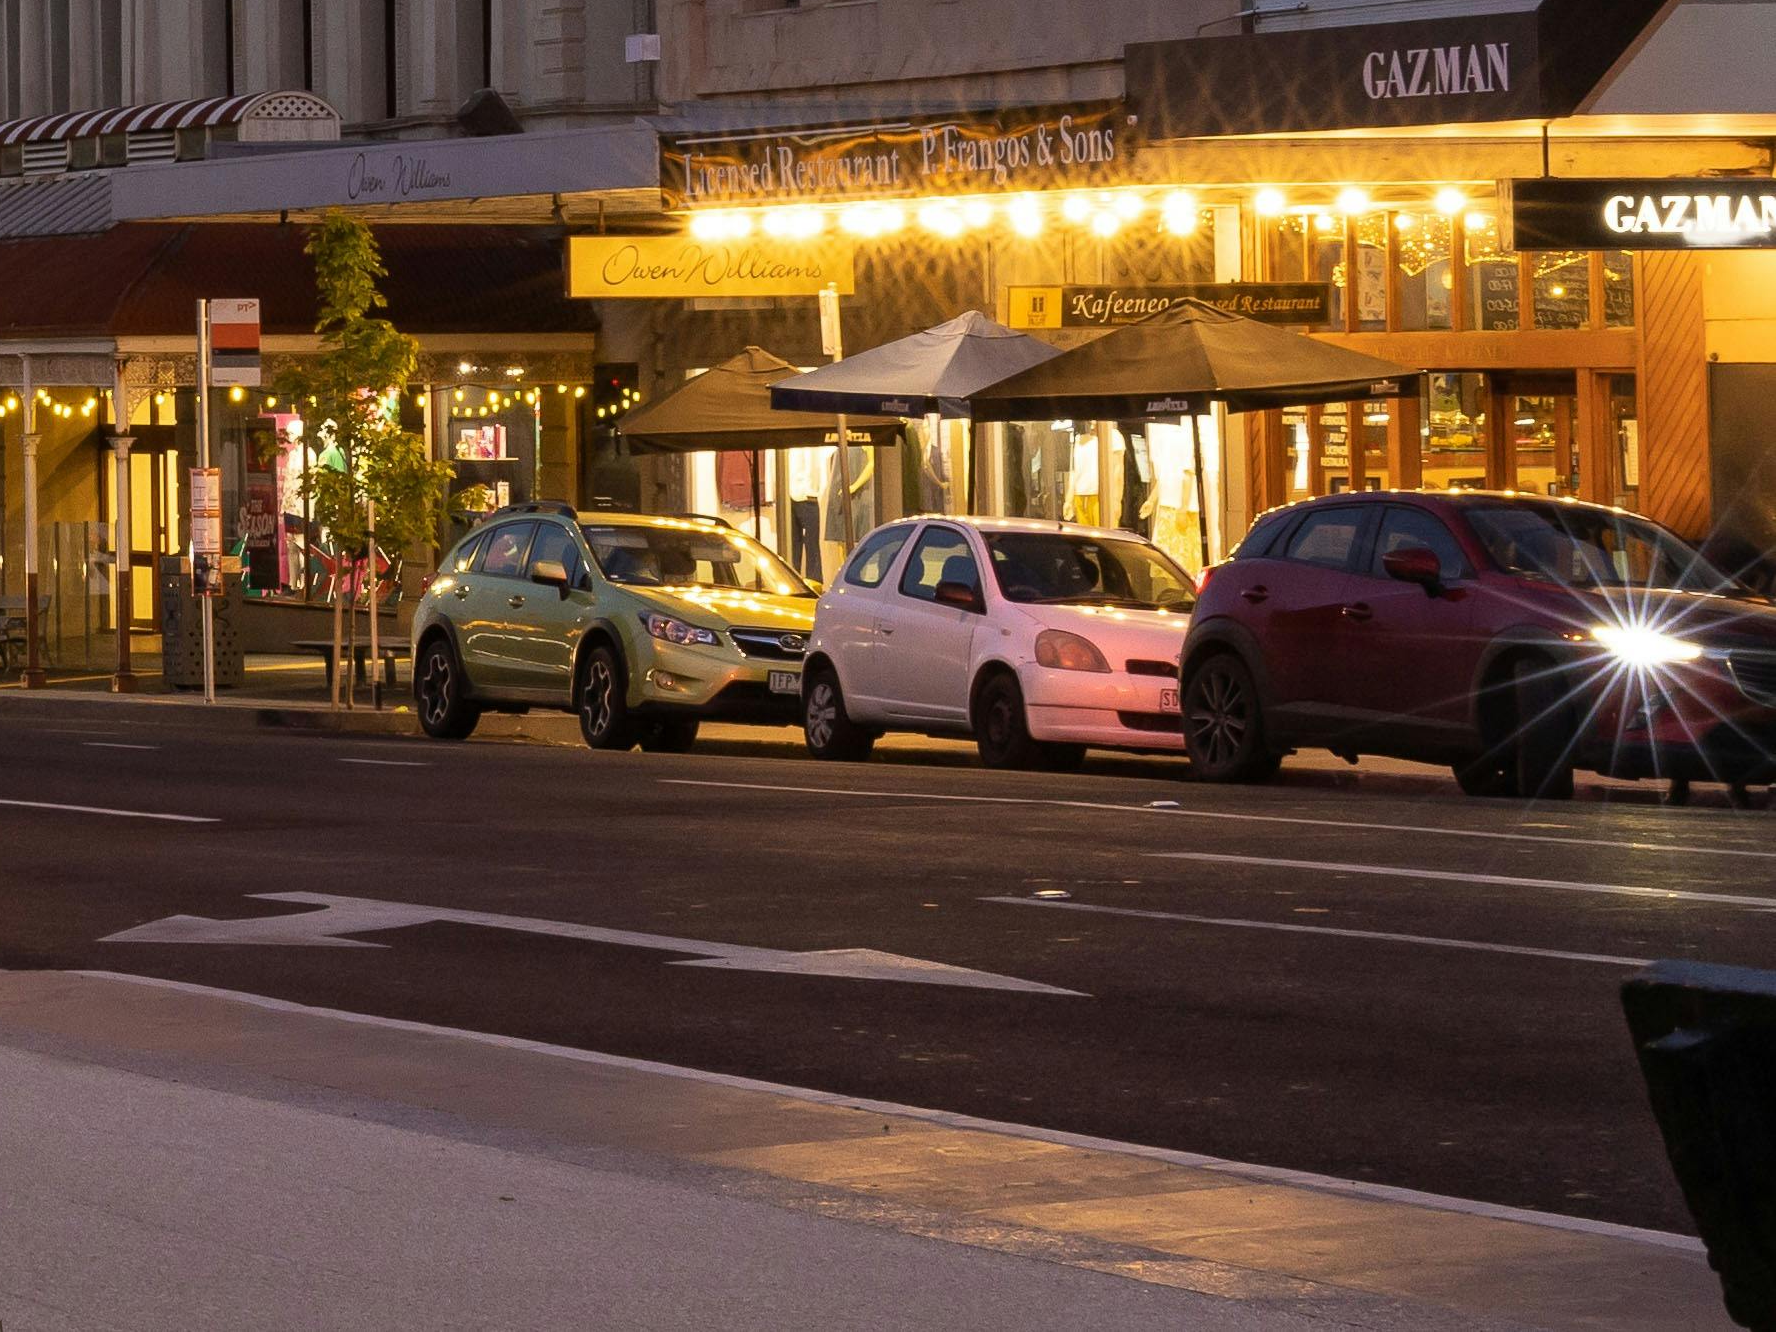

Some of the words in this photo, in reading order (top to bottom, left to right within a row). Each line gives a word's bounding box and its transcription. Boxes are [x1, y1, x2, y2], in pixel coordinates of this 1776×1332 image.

[1362, 43, 1510, 99] GAZMAN
[348, 153, 386, 199] Owen
[393, 155, 451, 195] Williams
[684, 145, 773, 196] Licensed
[777, 146, 900, 190] Restaurant
[942, 125, 1030, 185] Frangos
[1037, 124, 1054, 166] &
[1060, 115, 1115, 164] Sons
[602, 245, 679, 286] Owen
[679, 245, 823, 285] Williams
[1241, 295, 1321, 312] Restaurant
